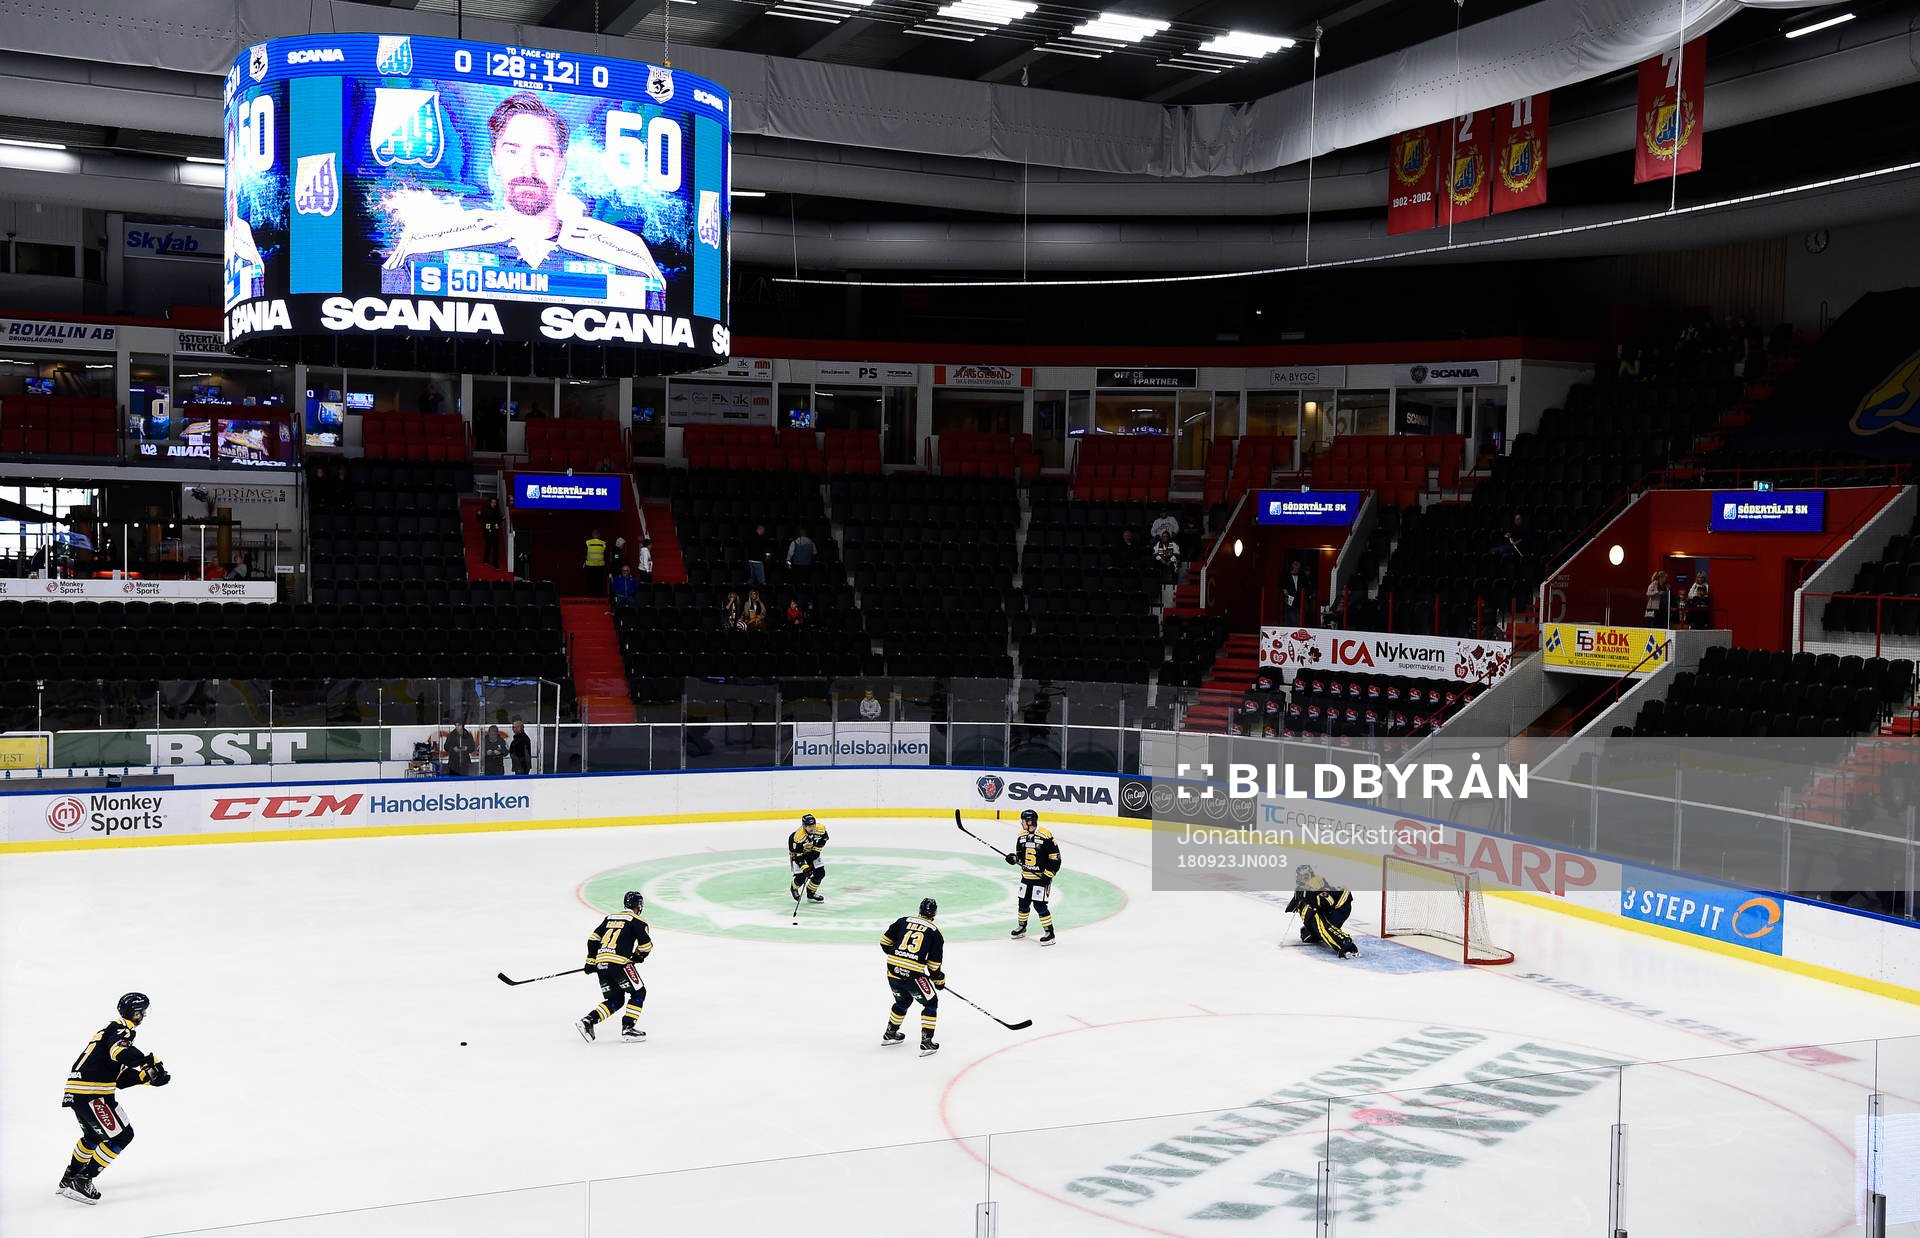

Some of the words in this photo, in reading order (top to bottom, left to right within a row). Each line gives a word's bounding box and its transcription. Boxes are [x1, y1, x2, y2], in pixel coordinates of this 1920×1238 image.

[287, 48, 345, 64] SCANIA
[454, 50, 472, 73] 0
[505, 47, 517, 55] TO
[520, 48, 561, 60] FACE-OFF
[492, 54, 575, 84] 28:12
[592, 66, 609, 88] 0
[513, 80, 544, 90] PERIOD
[1458, 111, 1473, 142] 2
[420, 266, 442, 292] S
[485, 270, 549, 293] SAHLIN
[320, 296, 504, 336] SCANIA
[9, 322, 86, 340] ROVALIN
[90, 327, 115, 340] AB
[178, 332, 224, 345] ÖSTERTÄL
[539, 306, 695, 349] SCANIA
[858, 367, 878, 379] PS
[1288, 372, 1316, 382] BYGG
[1430, 368, 1479, 379] SCANIA
[541, 485, 594, 496] SÖDERTÄLJE
[595, 487, 608, 496] SK
[1283, 502, 1334, 511] SÖDERTÄLJE
[1334, 503, 1347, 512] SK
[1737, 503, 1794, 514] SÖDERTÄLJE
[1795, 504, 1808, 514] SK
[1596, 629, 1630, 647] KÖK
[1331, 638, 1375, 667] ICA
[1375, 640, 1445, 664] Nykvarn
[146, 732, 308, 767] BST
[794, 740, 929, 756] Handelsbanken
[90, 794, 163, 813] Monkey
[370, 792, 530, 814] Handelsbanken
[1007, 781, 1114, 806] SCANIA
[209, 793, 364, 821] CCM
[1260, 803, 1285, 825] TC
[90, 812, 163, 835] Sports
[1392, 818, 1598, 898] SHARP
[1623, 885, 1636, 911] 3
[1640, 892, 1695, 924] STEP
[1700, 904, 1725, 932] IT
[600, 928, 622, 950] 41
[898, 930, 925, 954] 13
